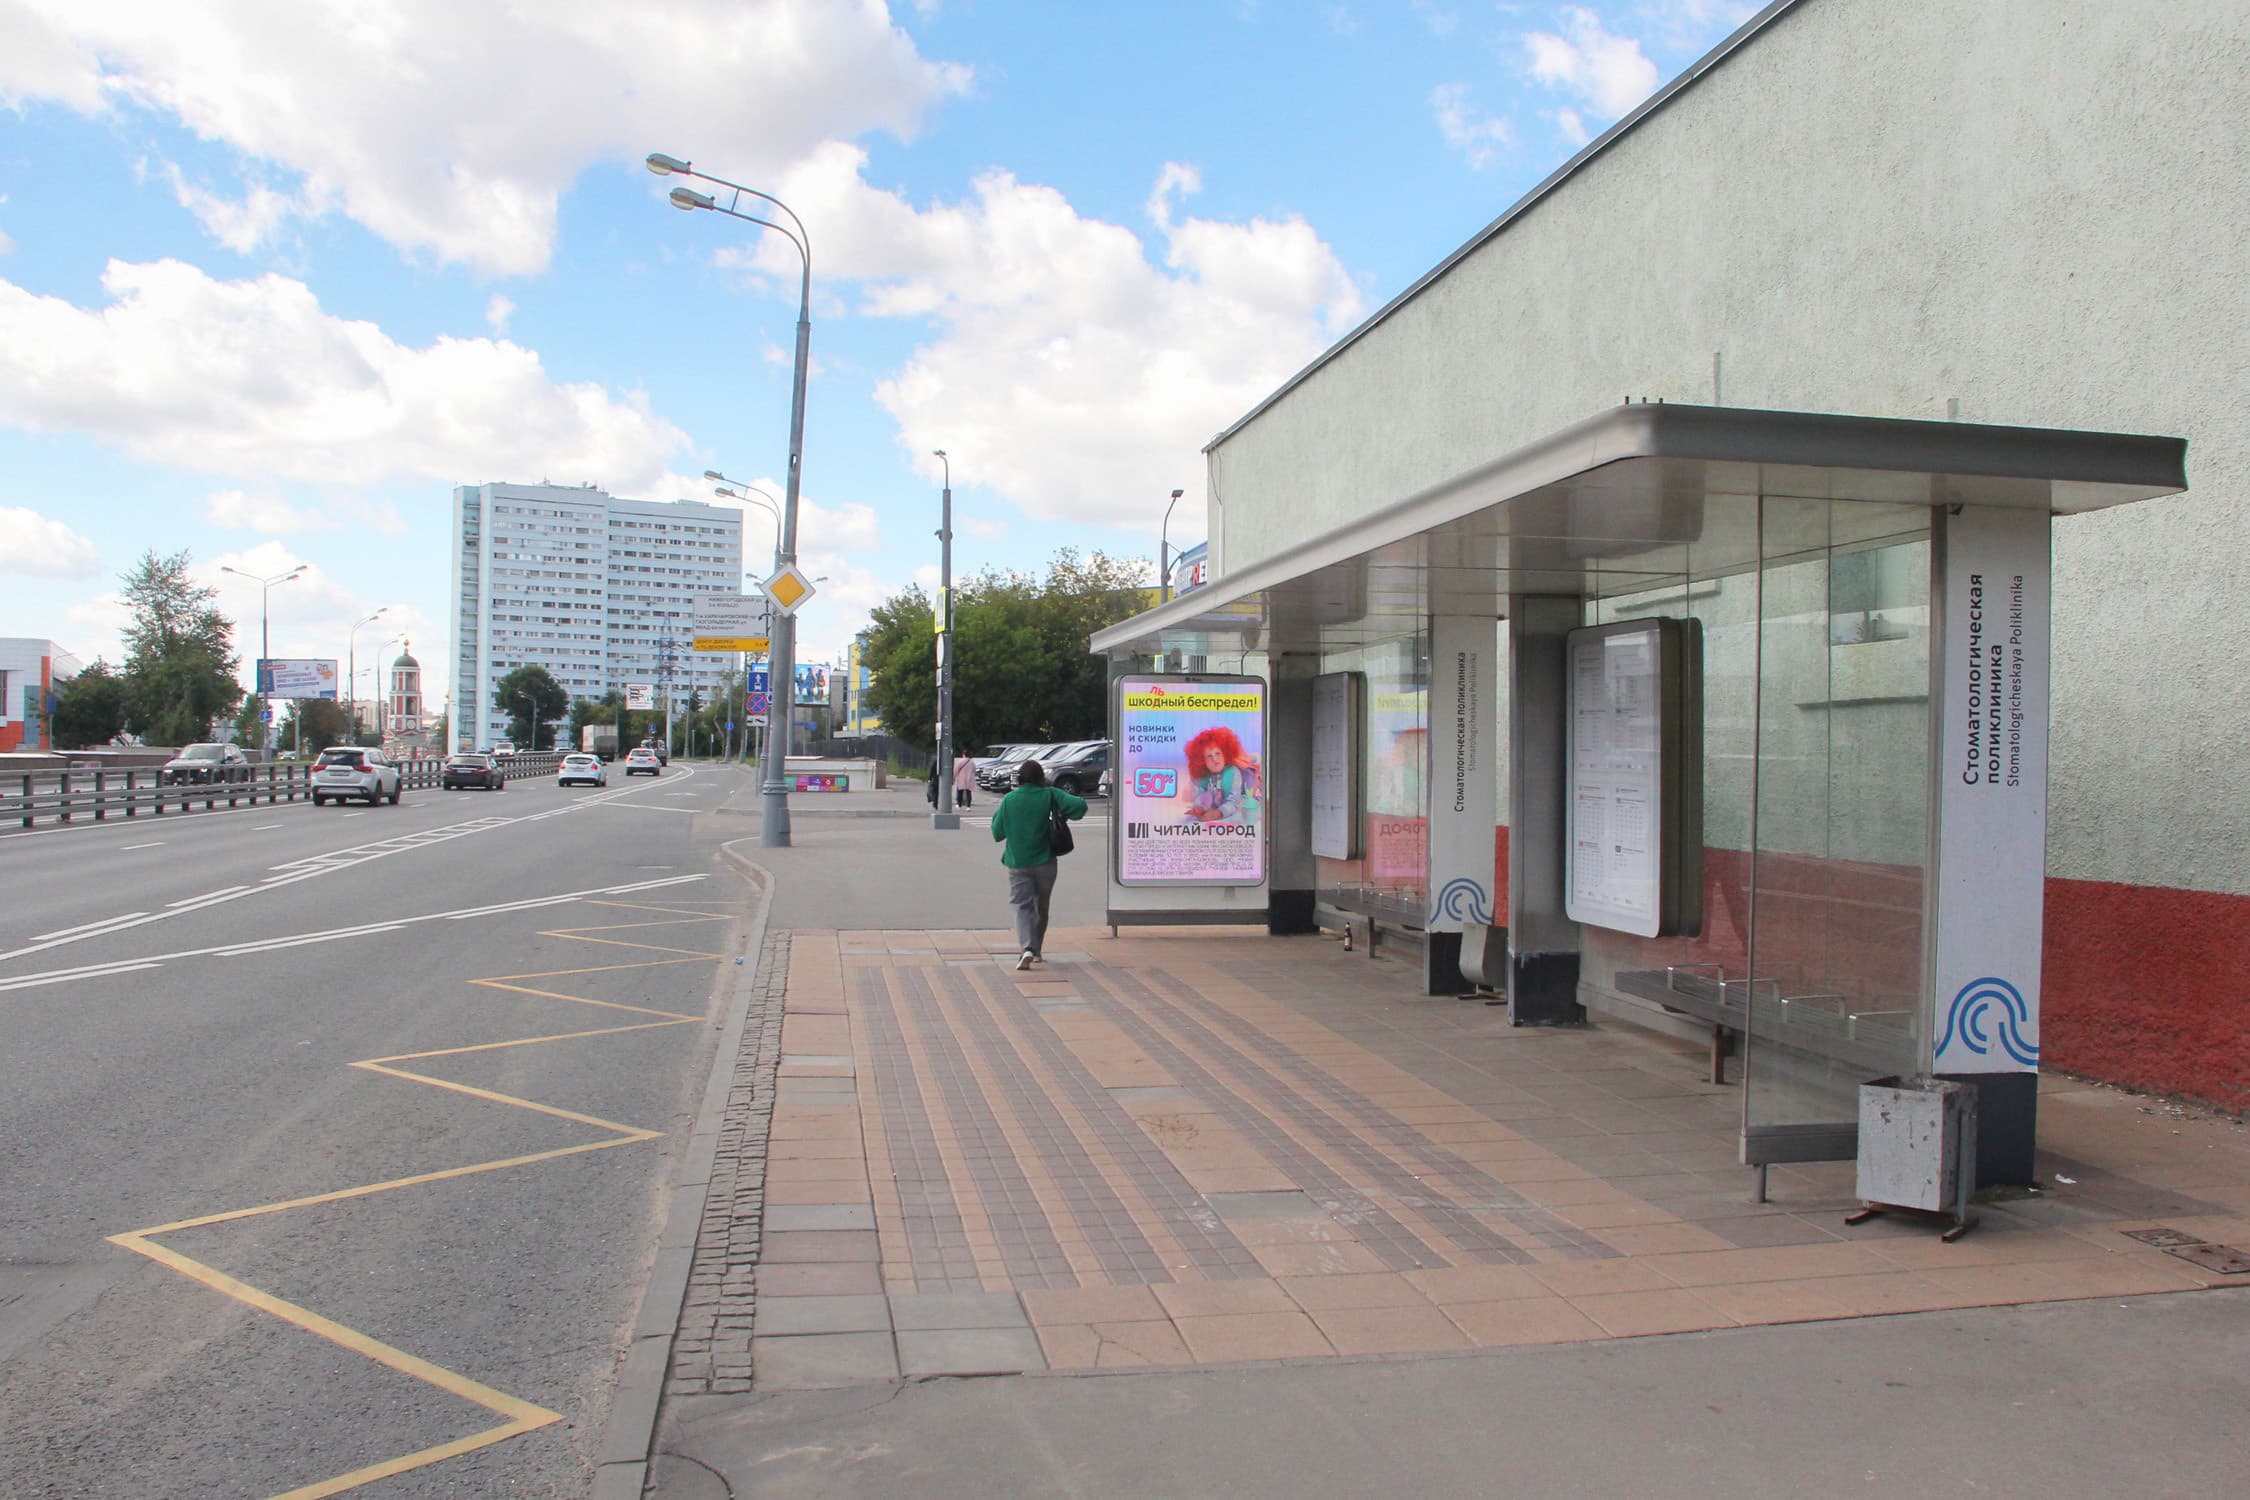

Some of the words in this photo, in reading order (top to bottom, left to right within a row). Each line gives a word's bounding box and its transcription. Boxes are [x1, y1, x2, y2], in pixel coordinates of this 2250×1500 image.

[2009, 575, 2022, 645] Poliklinika
[1187, 696, 1258, 710] беспредел!
[1457, 652, 1466, 715] поликлиника
[1962, 574, 1983, 785] Стоматологическая
[1128, 724, 1175, 733] новинки
[1128, 734, 1136, 742] и
[1137, 734, 1176, 743] скидки
[1987, 644, 2002, 784] поликлиника
[2007, 648, 2024, 787] Stomatologicheskaya
[1128, 744, 1143, 754] до
[1453, 717, 1466, 813] Стоматологическая
[1153, 822, 1256, 838] ЧИТАЙ-ГОРОД
